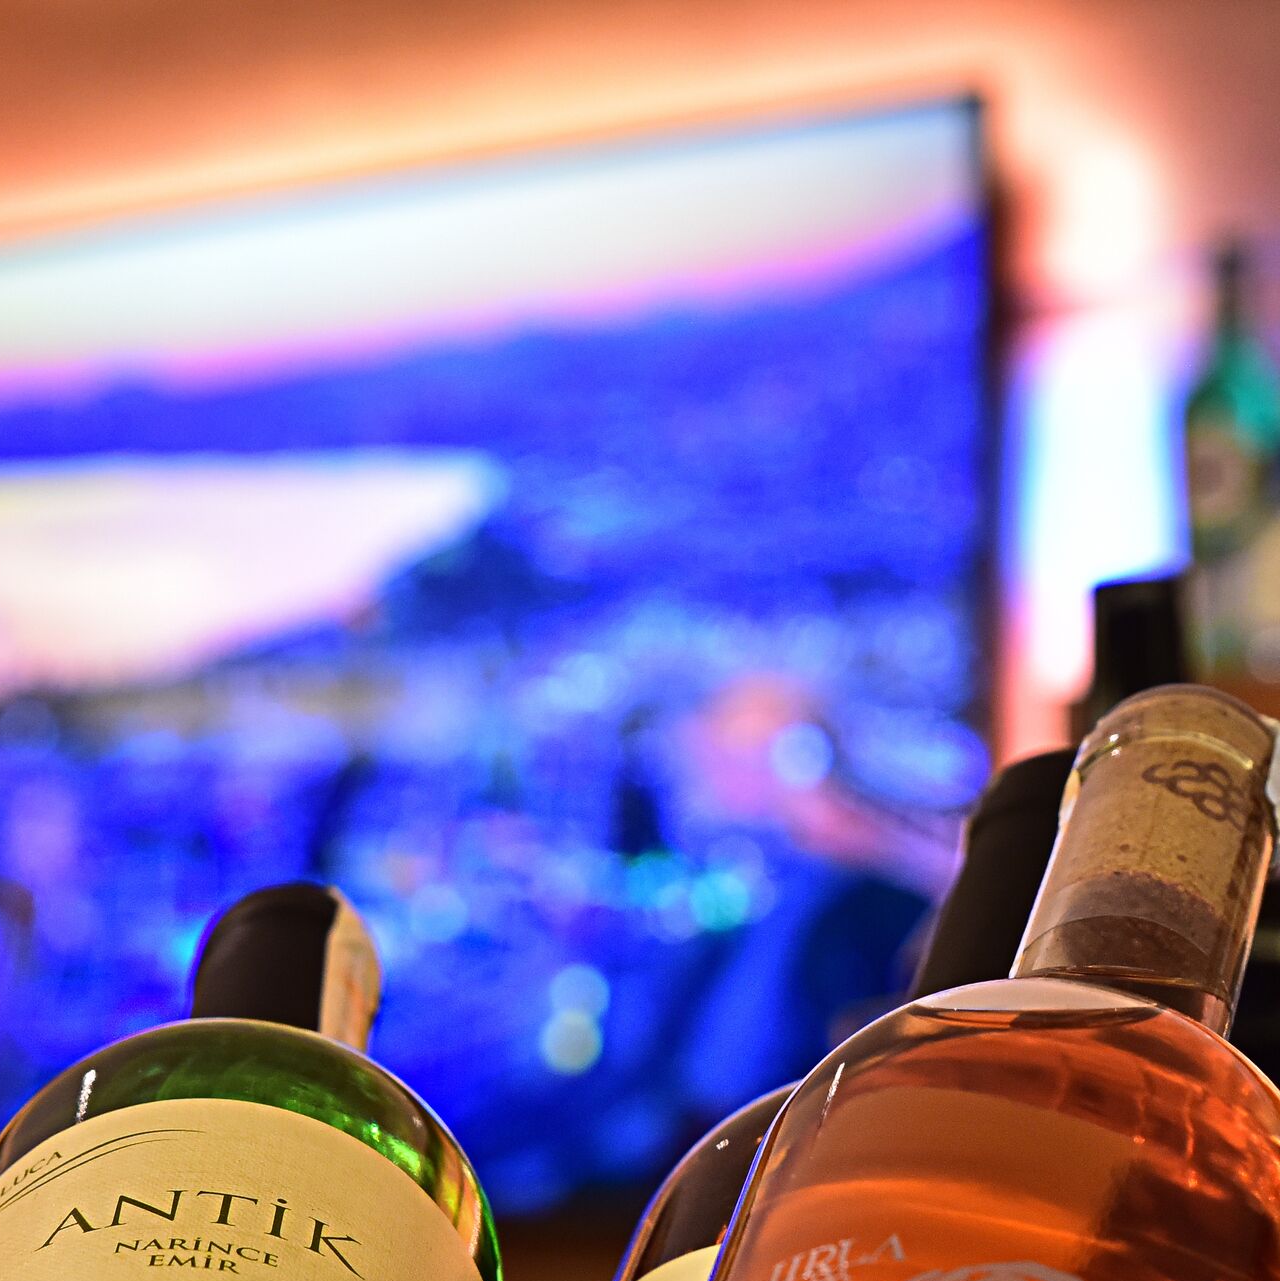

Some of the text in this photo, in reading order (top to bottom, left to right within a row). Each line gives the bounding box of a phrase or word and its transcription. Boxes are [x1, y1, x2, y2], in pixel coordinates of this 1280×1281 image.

[34, 1189, 366, 1281] ANTİK
[114, 1236, 280, 1269] NARİNCE
[147, 1252, 241, 1275] EMİR
